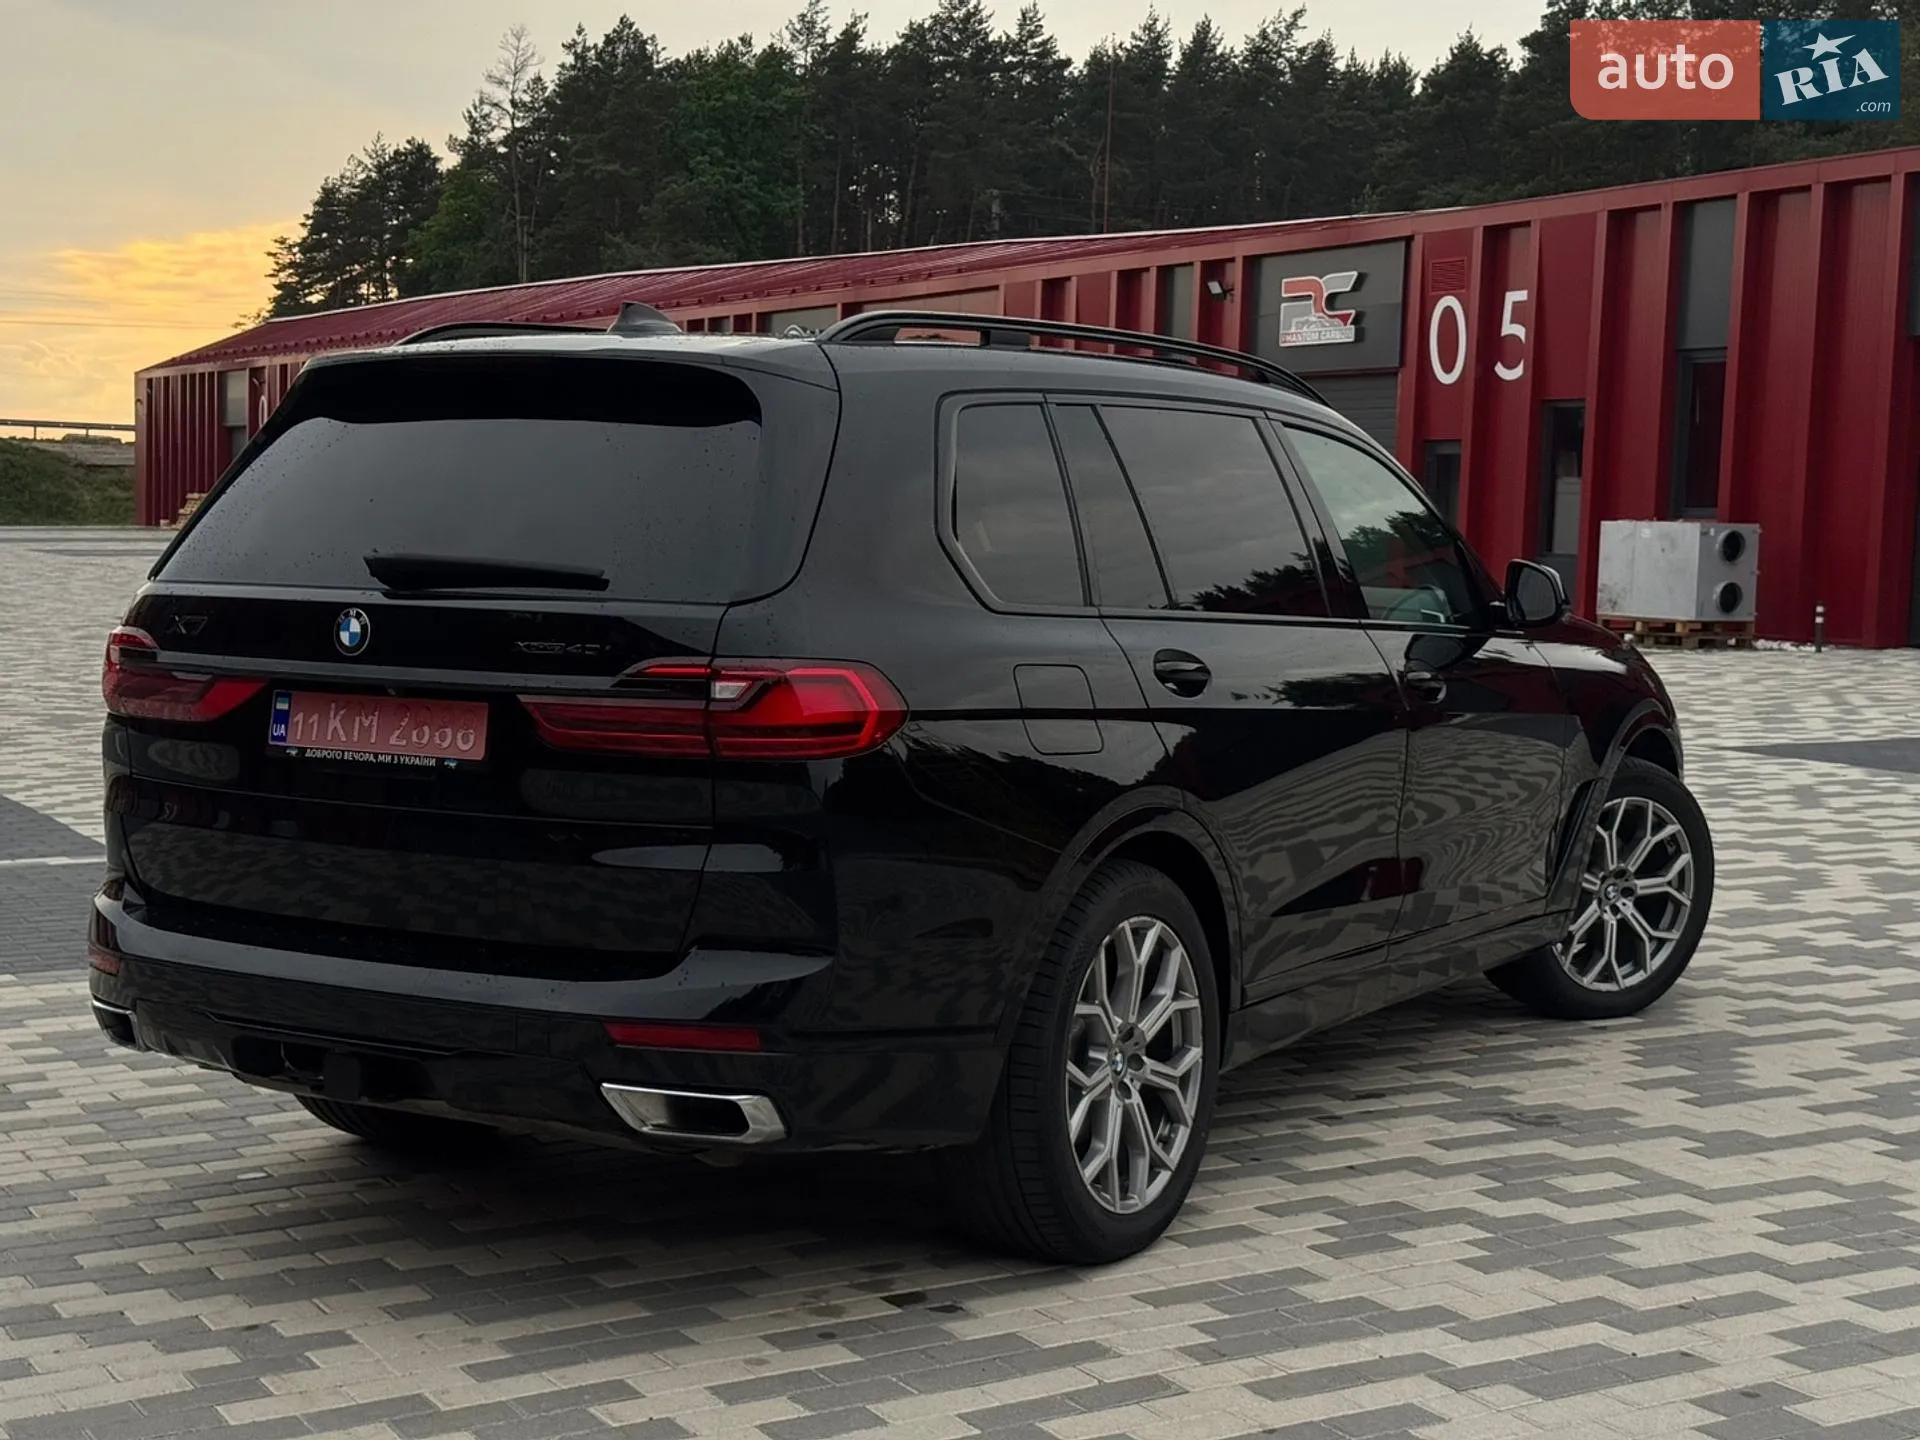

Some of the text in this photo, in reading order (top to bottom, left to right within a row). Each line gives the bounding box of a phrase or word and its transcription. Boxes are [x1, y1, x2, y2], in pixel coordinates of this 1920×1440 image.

[272, 723, 287, 737] UA
[305, 748, 343, 760] ДОБРОГО
[377, 753, 391, 763] МИ
[400, 754, 436, 767] УКРАЇНИ
